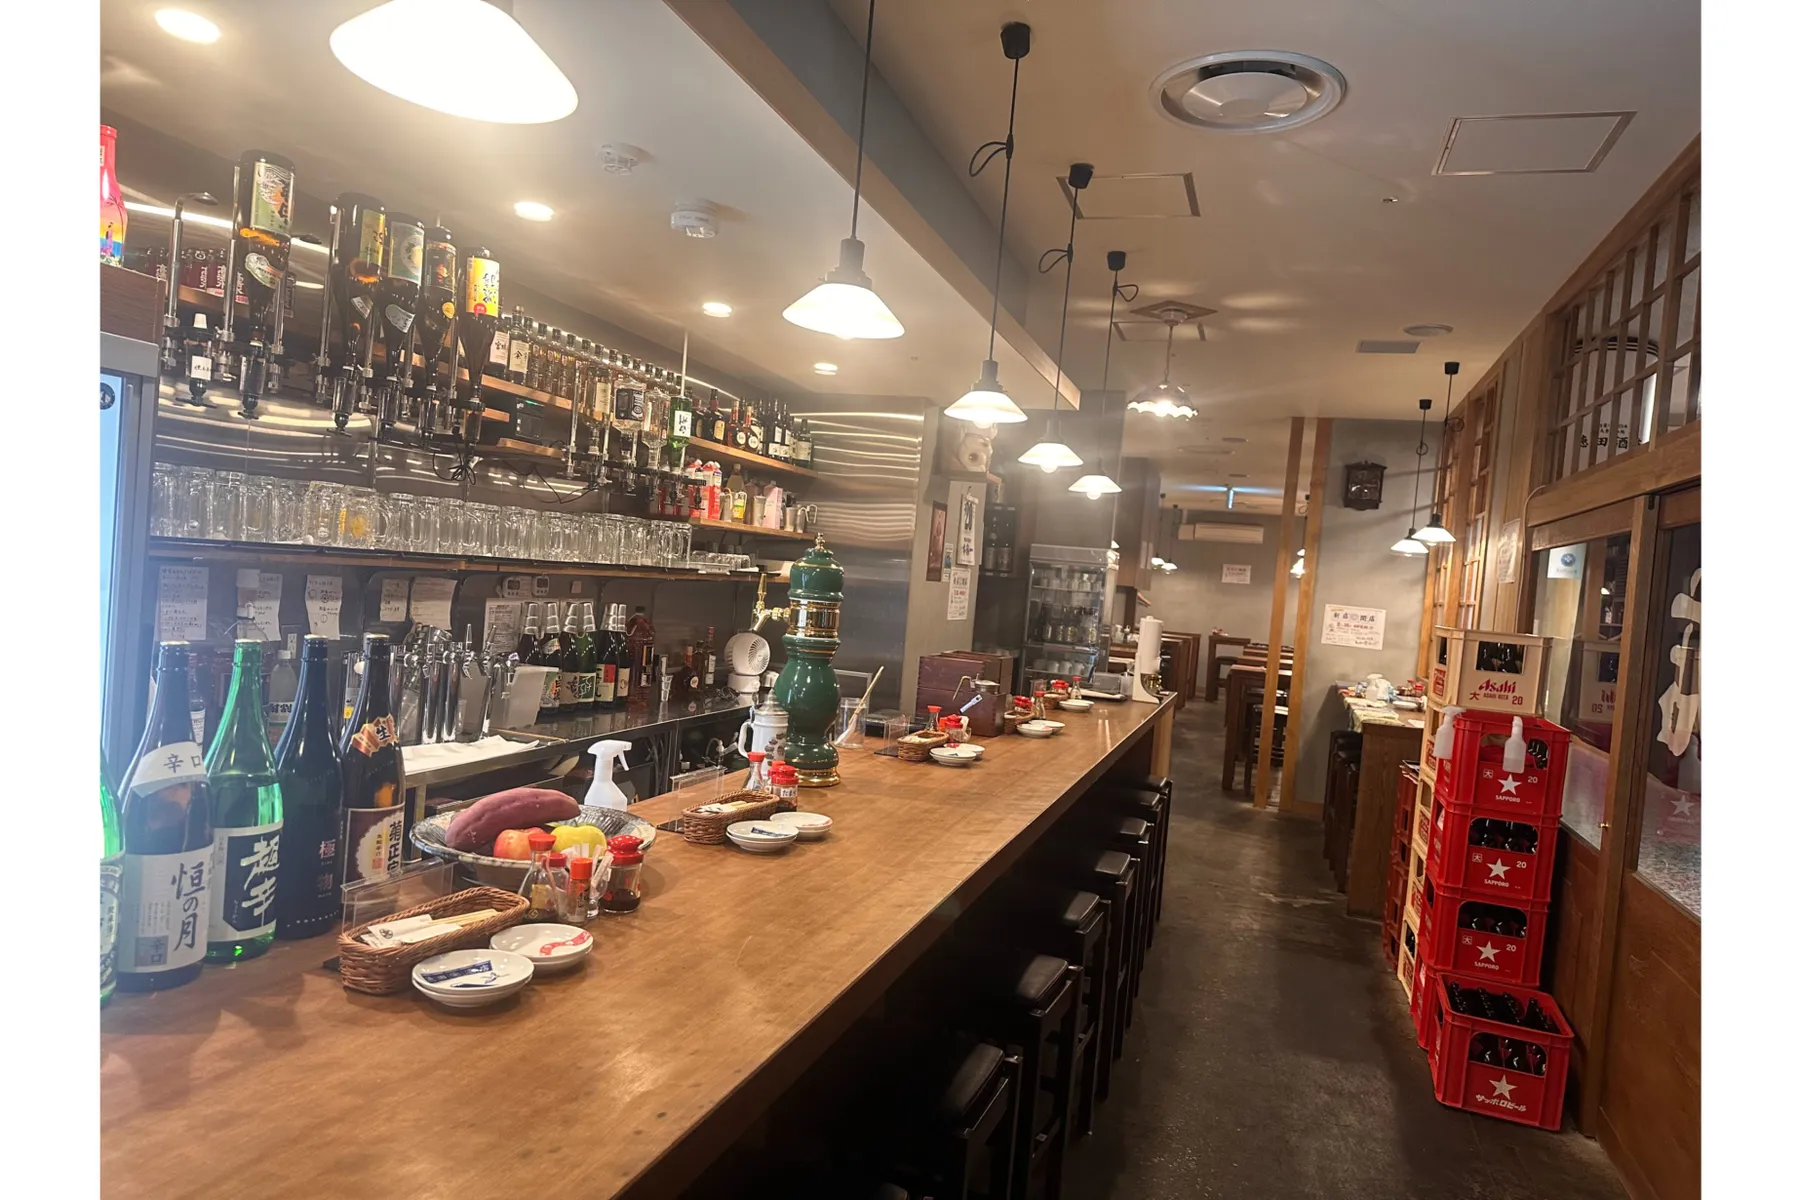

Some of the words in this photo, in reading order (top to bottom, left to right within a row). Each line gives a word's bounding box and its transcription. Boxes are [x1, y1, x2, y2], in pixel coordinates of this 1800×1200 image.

[1478, 678, 1517, 694] Asahi
[1469, 691, 1480, 701] 大
[1512, 695, 1523, 705] 20
[376, 725, 391, 741] 生
[163, 753, 202, 774] 辛口
[1527, 775, 1538, 784] 20
[1495, 794, 1520, 803] SAPPORO
[1516, 860, 1527, 869] 20
[240, 834, 280, 927] 超辛
[1484, 878, 1509, 888] SAPPORO
[171, 861, 205, 952] 恒の月
[1506, 943, 1517, 952] 20
[1474, 961, 1500, 970] SAPPORO
[1475, 1094, 1527, 1112] サッポロビール
